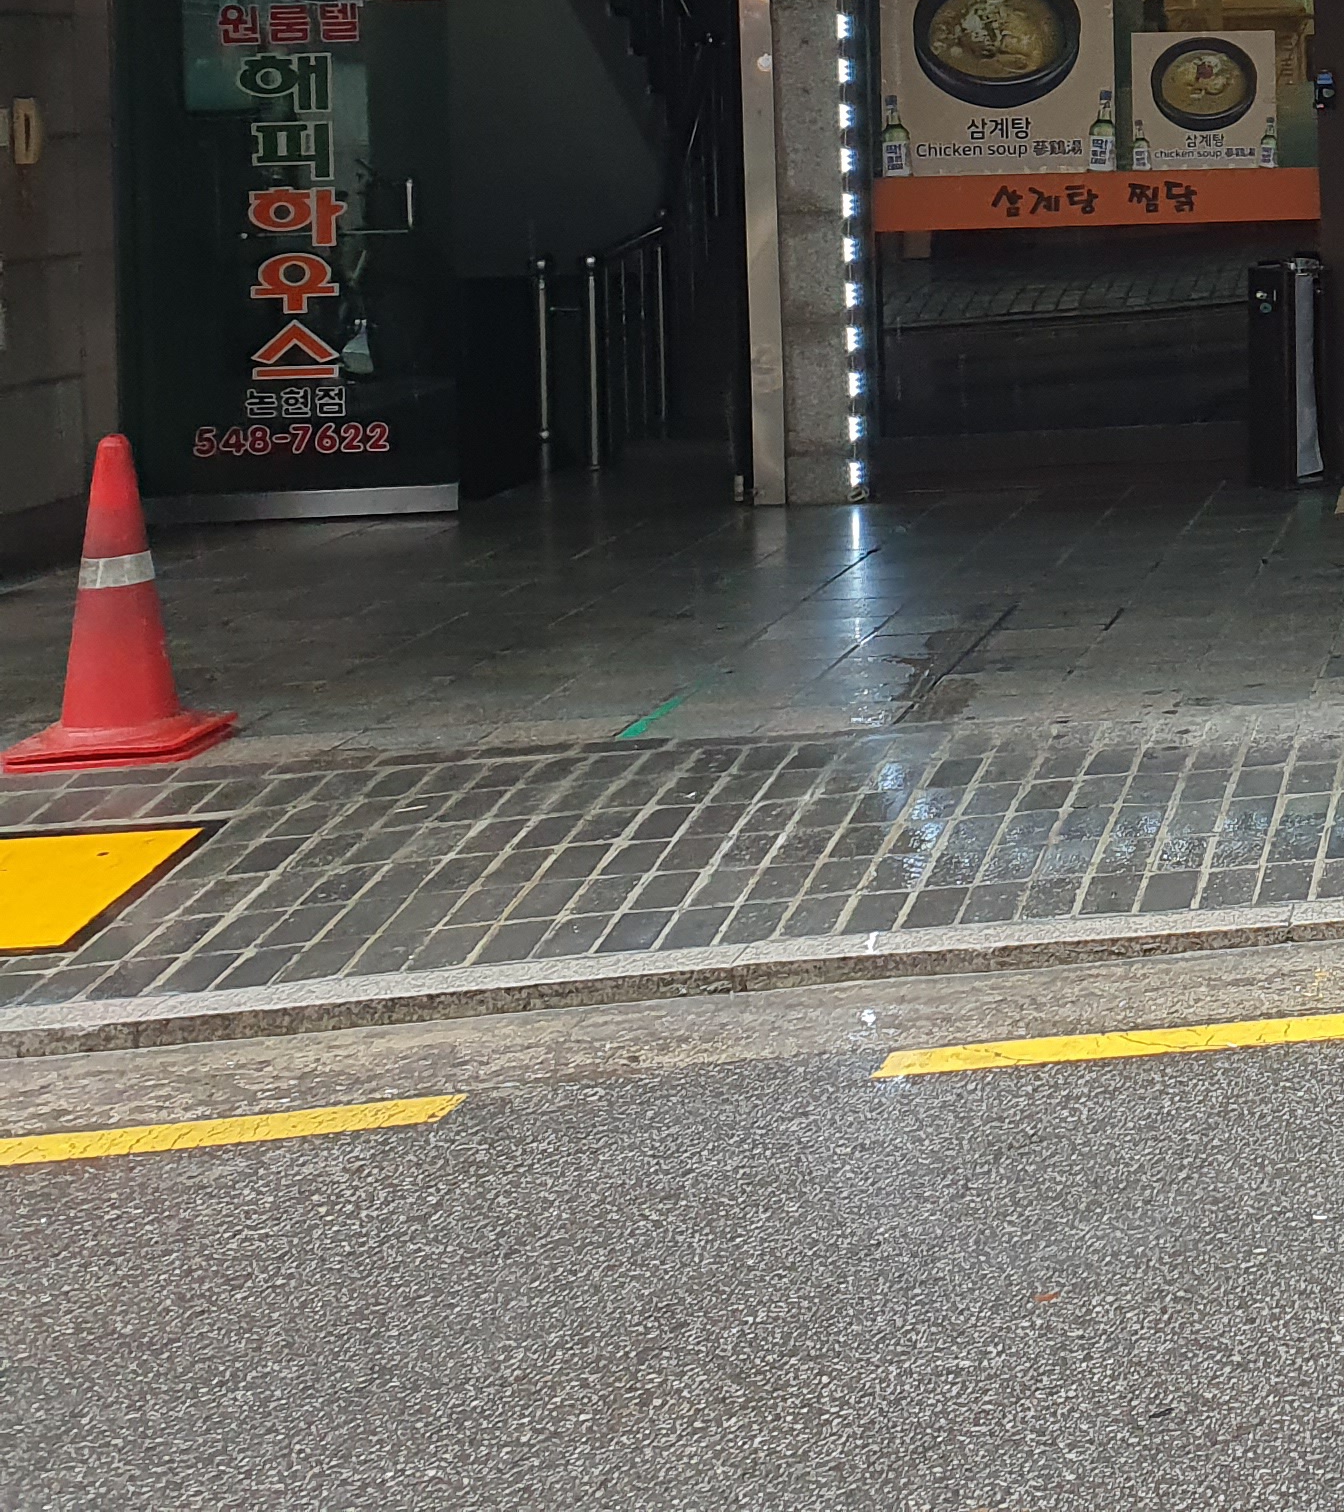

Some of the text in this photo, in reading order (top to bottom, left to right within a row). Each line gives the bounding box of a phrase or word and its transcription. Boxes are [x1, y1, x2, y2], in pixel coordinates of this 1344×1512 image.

[217, 2, 360, 45] 원룸텔
[966, 117, 1032, 140] 삼계탕
[916, 142, 983, 158] Chicken
[988, 143, 1028, 159] soup
[235, 51, 347, 381] 해피하우스
[991, 184, 1099, 218] 삼계탕
[244, 385, 347, 419] 논현점
[192, 422, 390, 458] 548-7622
